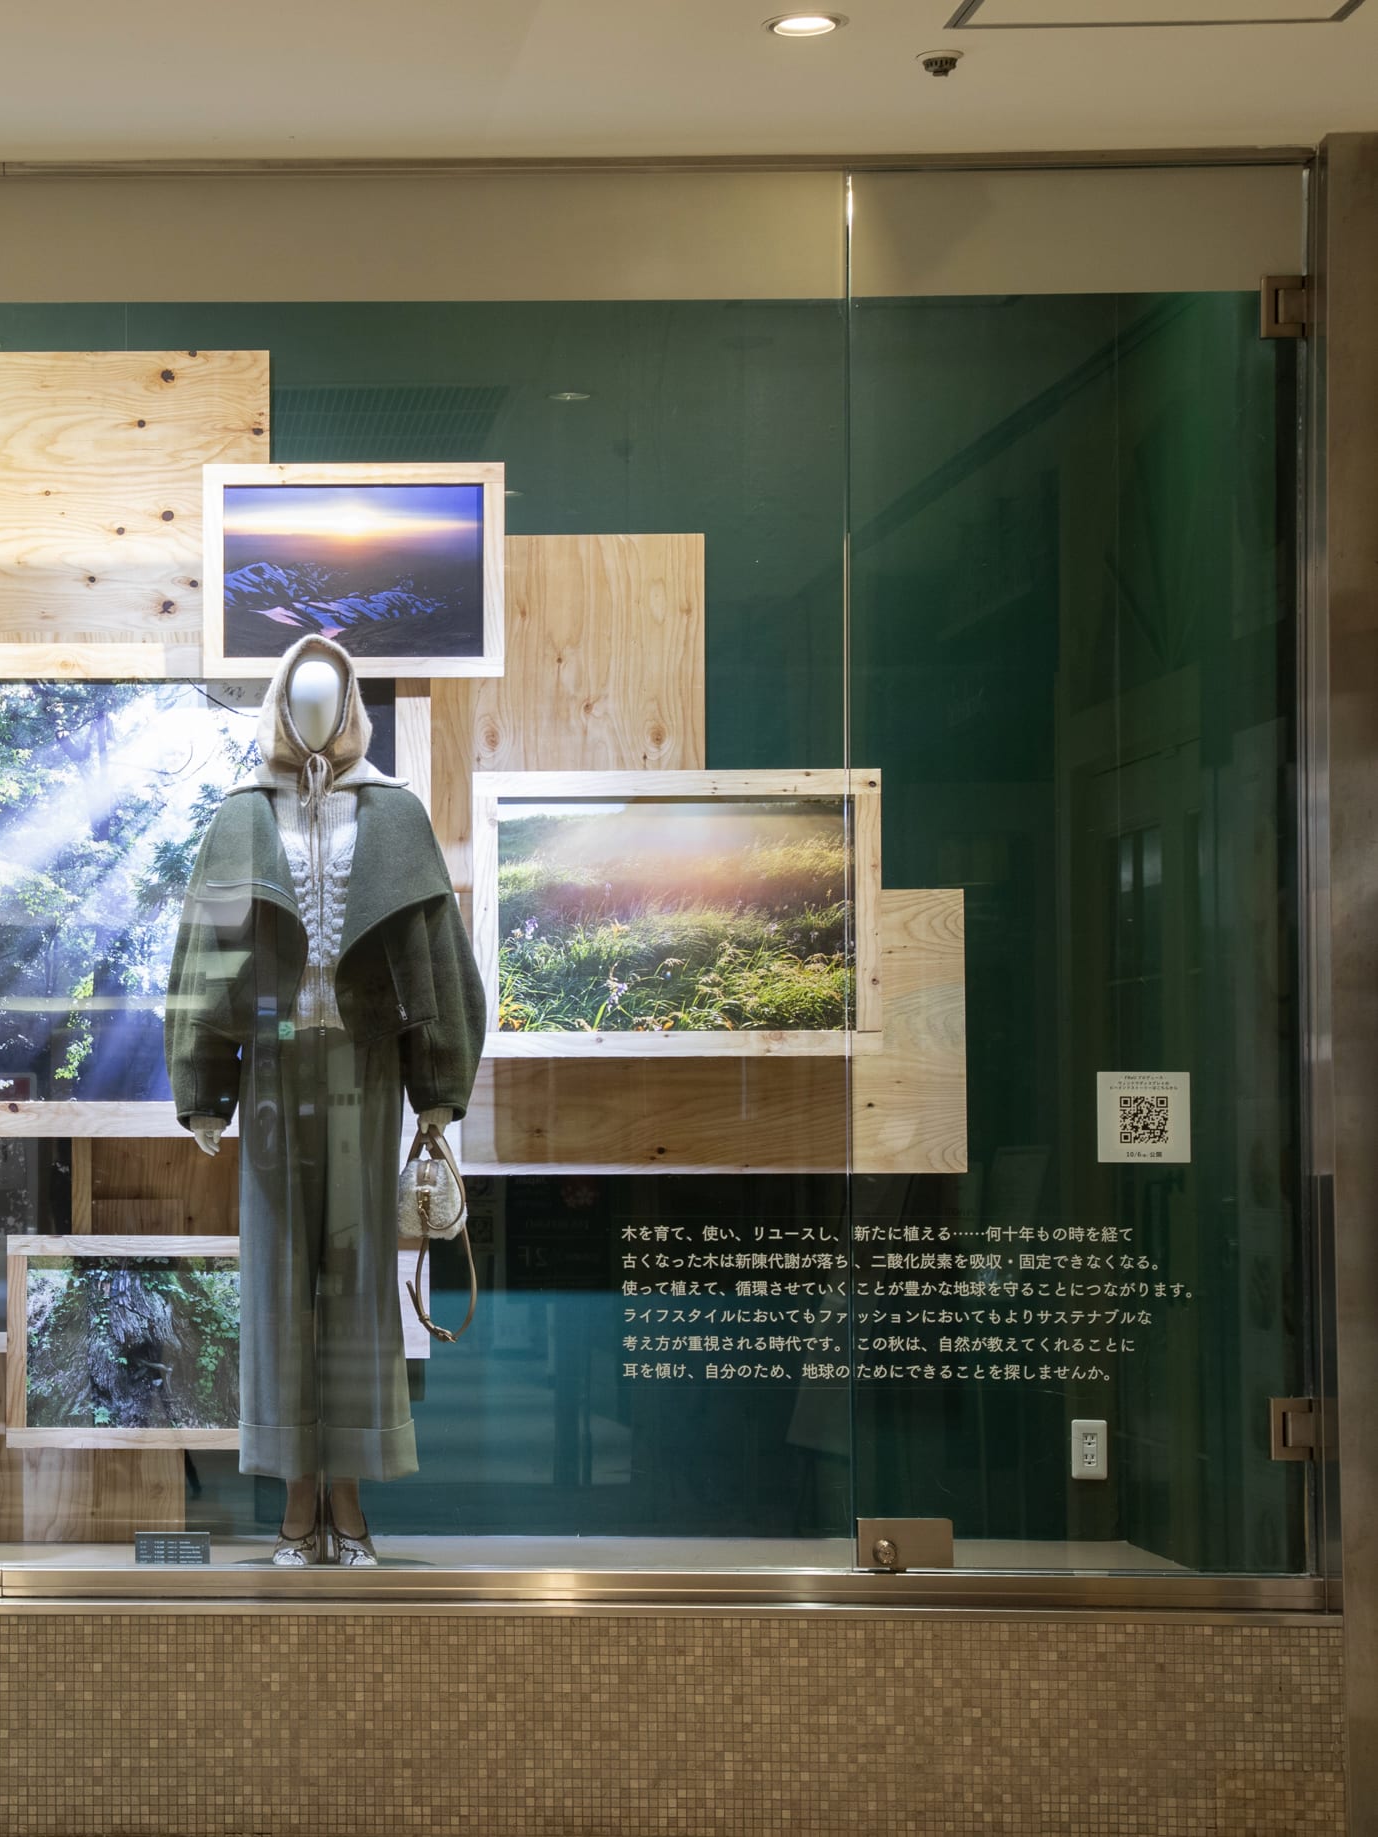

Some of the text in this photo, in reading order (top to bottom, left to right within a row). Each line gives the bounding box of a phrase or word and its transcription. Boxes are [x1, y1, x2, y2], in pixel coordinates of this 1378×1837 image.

[621, 1253, 1159, 1270] 古くなった木は新陳代謝が落ち、二酸化炭素を吸収・固定できなくなる。
[621, 1280, 1193, 1298] 使って植えて、循環させていくことが豊かな地球を守ることにつながります。
[623, 1308, 1153, 1325] ライフスタイルにおいてもファッションにおいてもよりサステナブルな
[622, 1335, 1135, 1353] 考え方が重視される時代です。この秋は、自然が教えてくれることに
[622, 1363, 1111, 1381] 耳を傾け、自分のため、地球のためにできることを探しませんか。
